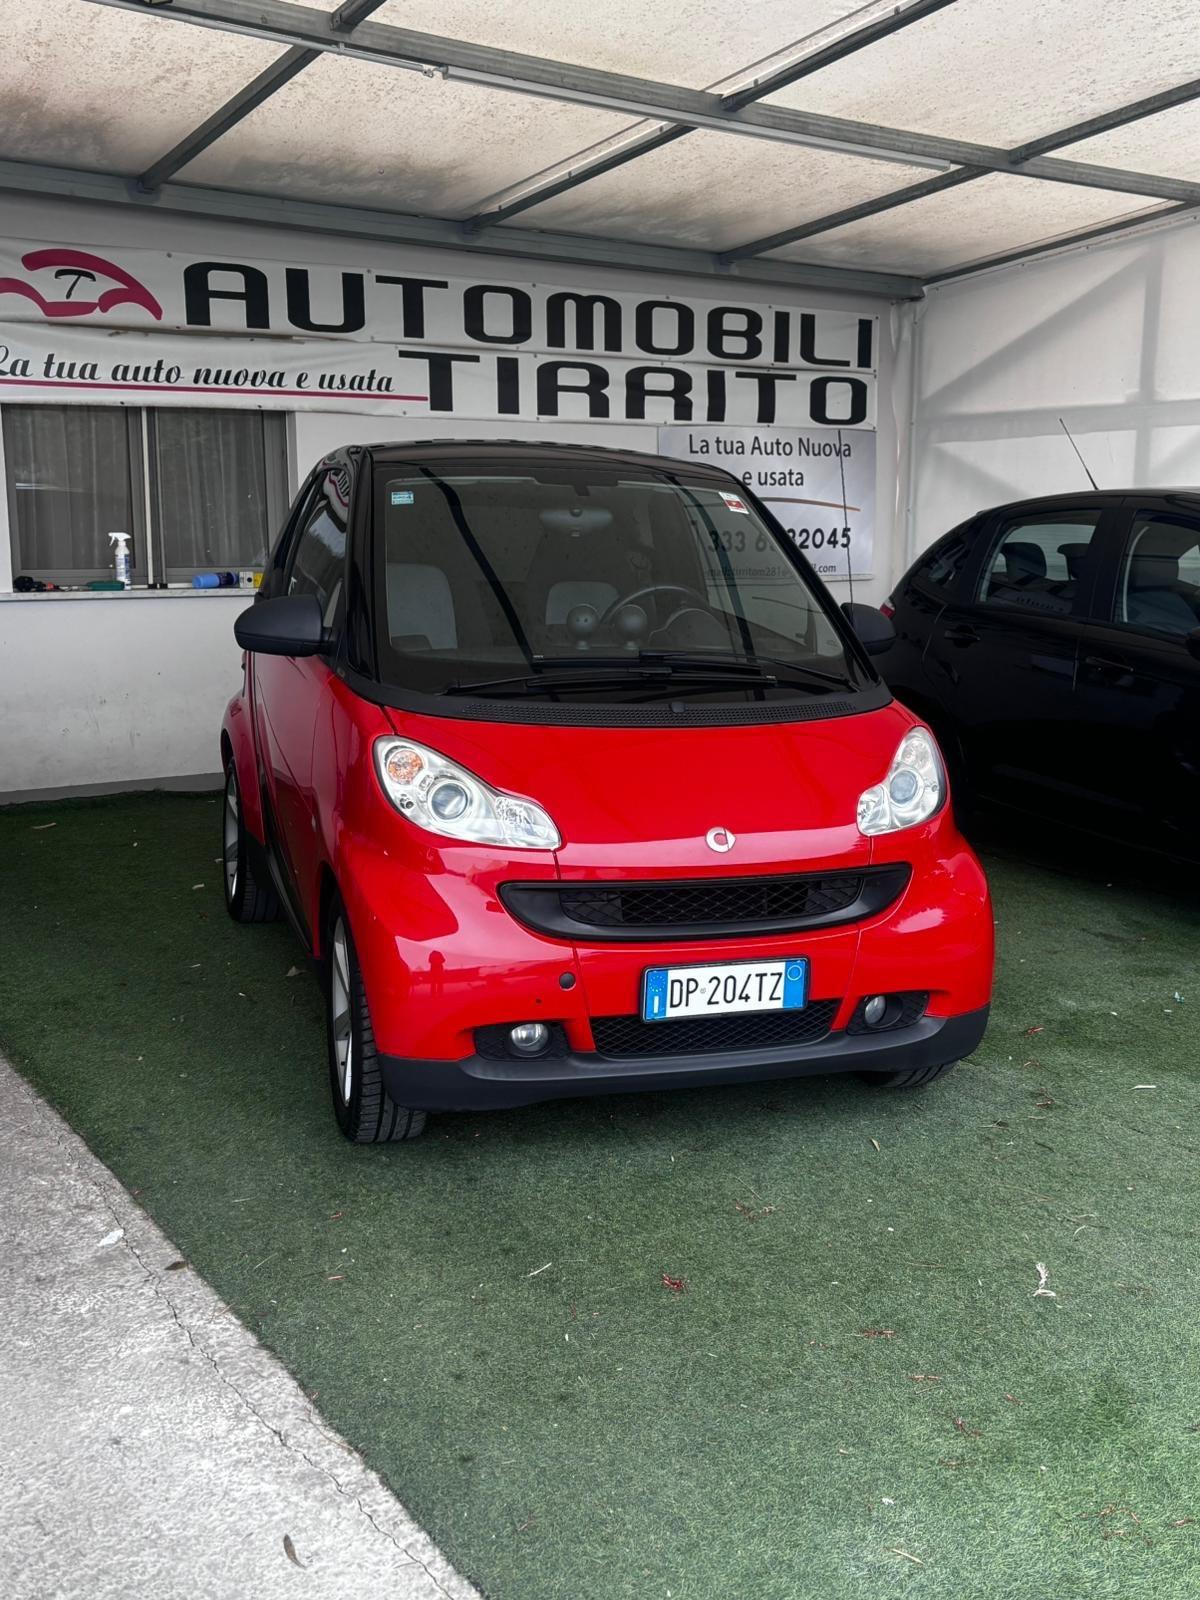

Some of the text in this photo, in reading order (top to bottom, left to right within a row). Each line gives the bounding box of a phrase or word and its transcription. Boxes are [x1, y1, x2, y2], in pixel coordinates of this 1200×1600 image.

[184, 261, 872, 368] AUTOMOBILI
[43, 353, 101, 380] tua
[111, 359, 184, 384] auto
[193, 368, 288, 388] nuova
[296, 371, 310, 389] e
[318, 369, 396, 392] usata
[398, 350, 868, 426] TIRRITO
[689, 434, 852, 457] La tua Auto Nuova
[742, 469, 804, 486] e usata
[670, 972, 783, 1008] DP 204TZ
